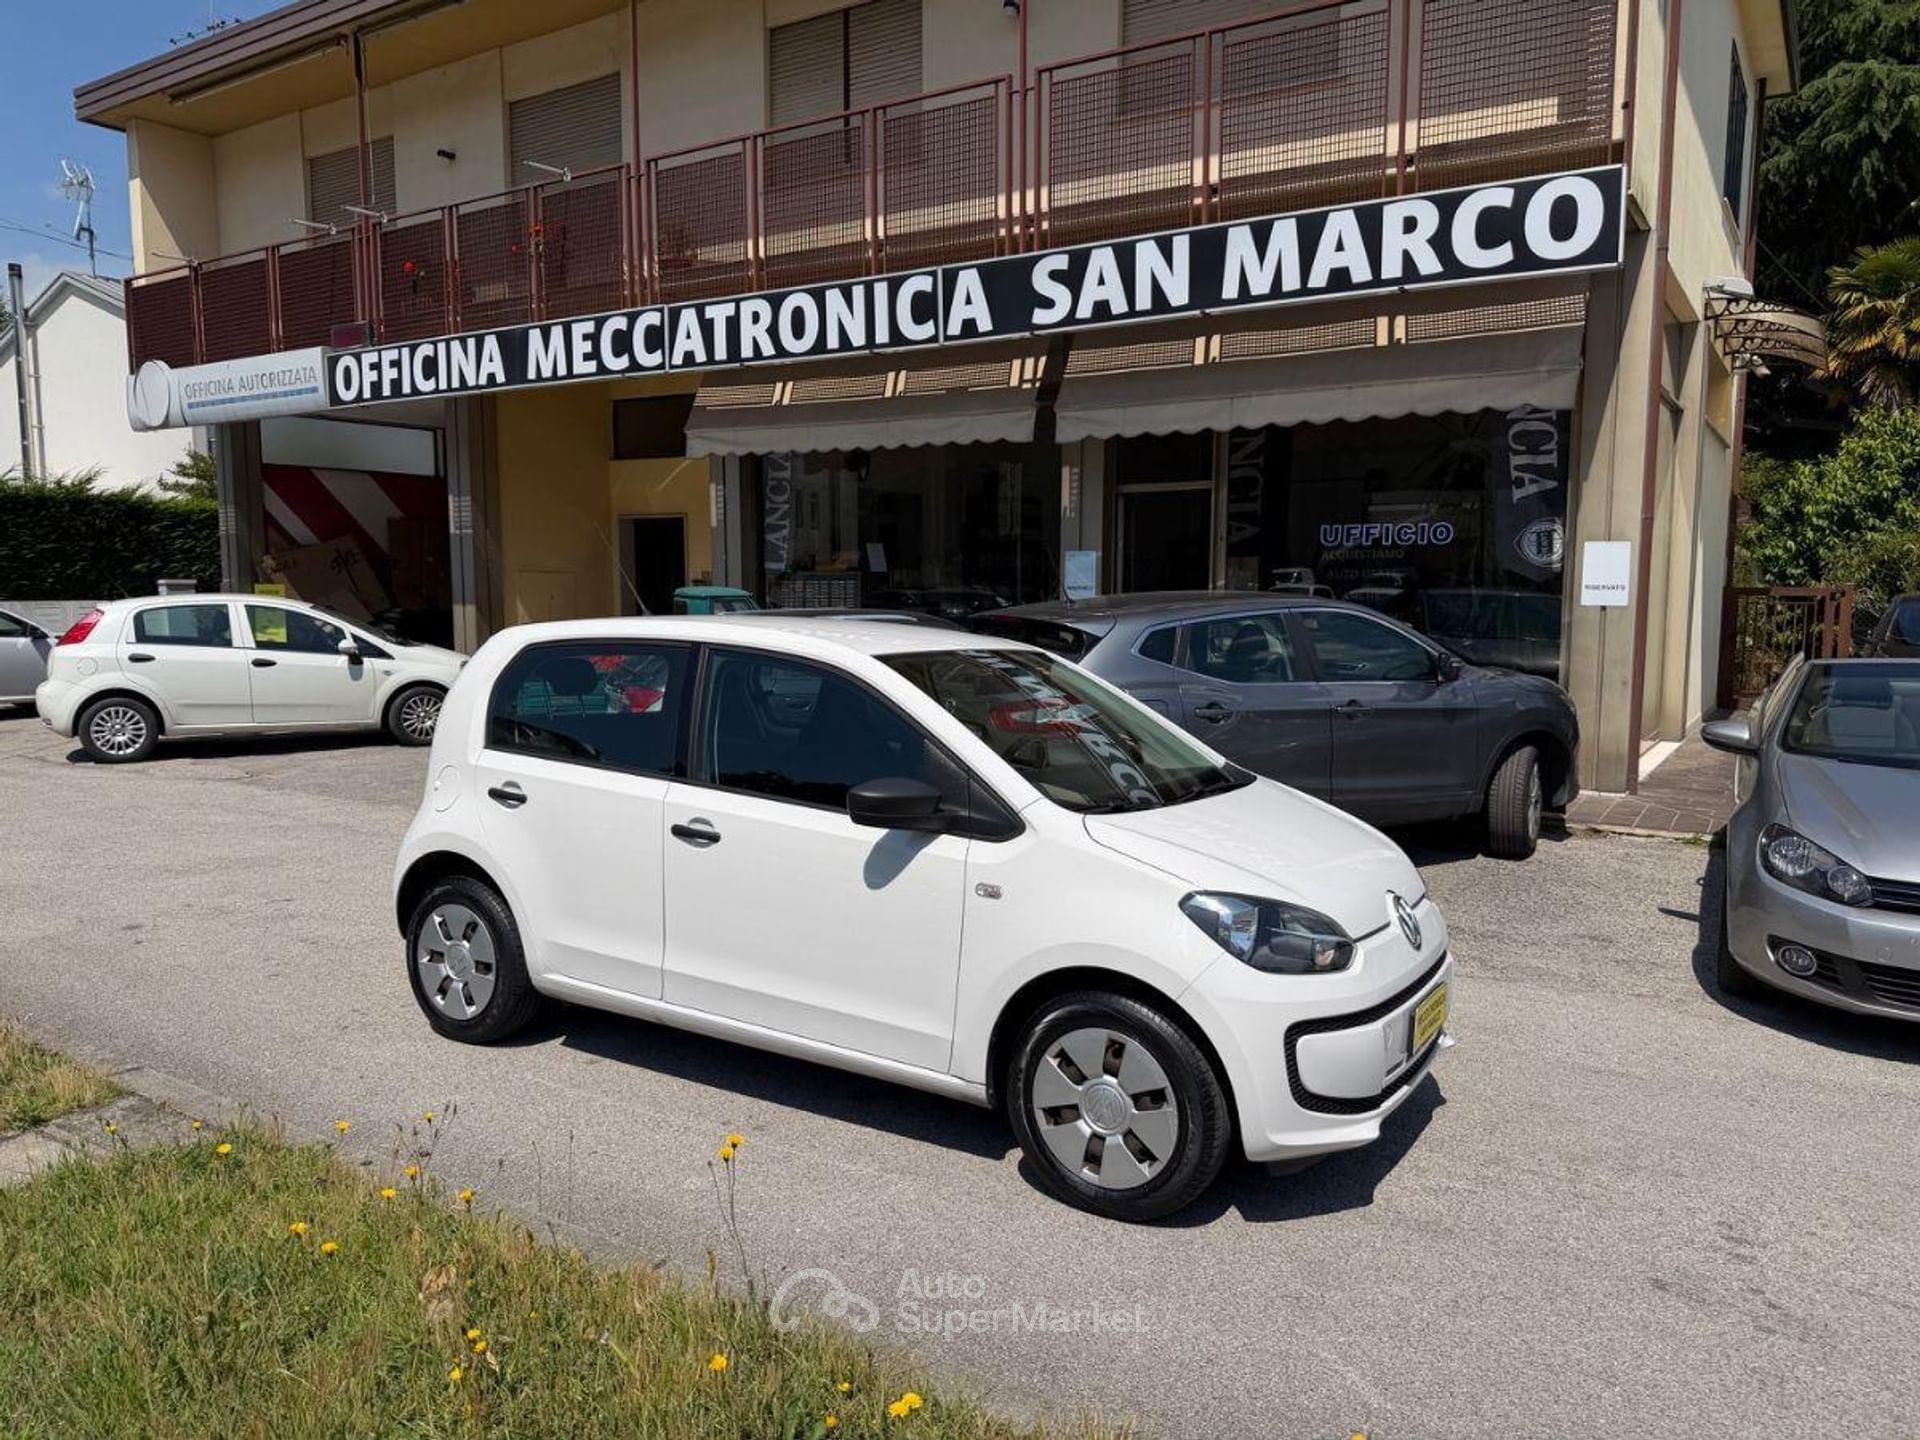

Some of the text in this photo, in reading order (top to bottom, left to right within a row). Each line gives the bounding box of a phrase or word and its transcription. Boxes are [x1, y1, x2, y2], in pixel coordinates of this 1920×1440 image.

[335, 175, 1605, 402] OFFICINA MECCATRONICA SAN MARCO
[184, 365, 318, 399] OFFICINA AUTORIZZATA
[1319, 521, 1454, 547] UFFICIO
